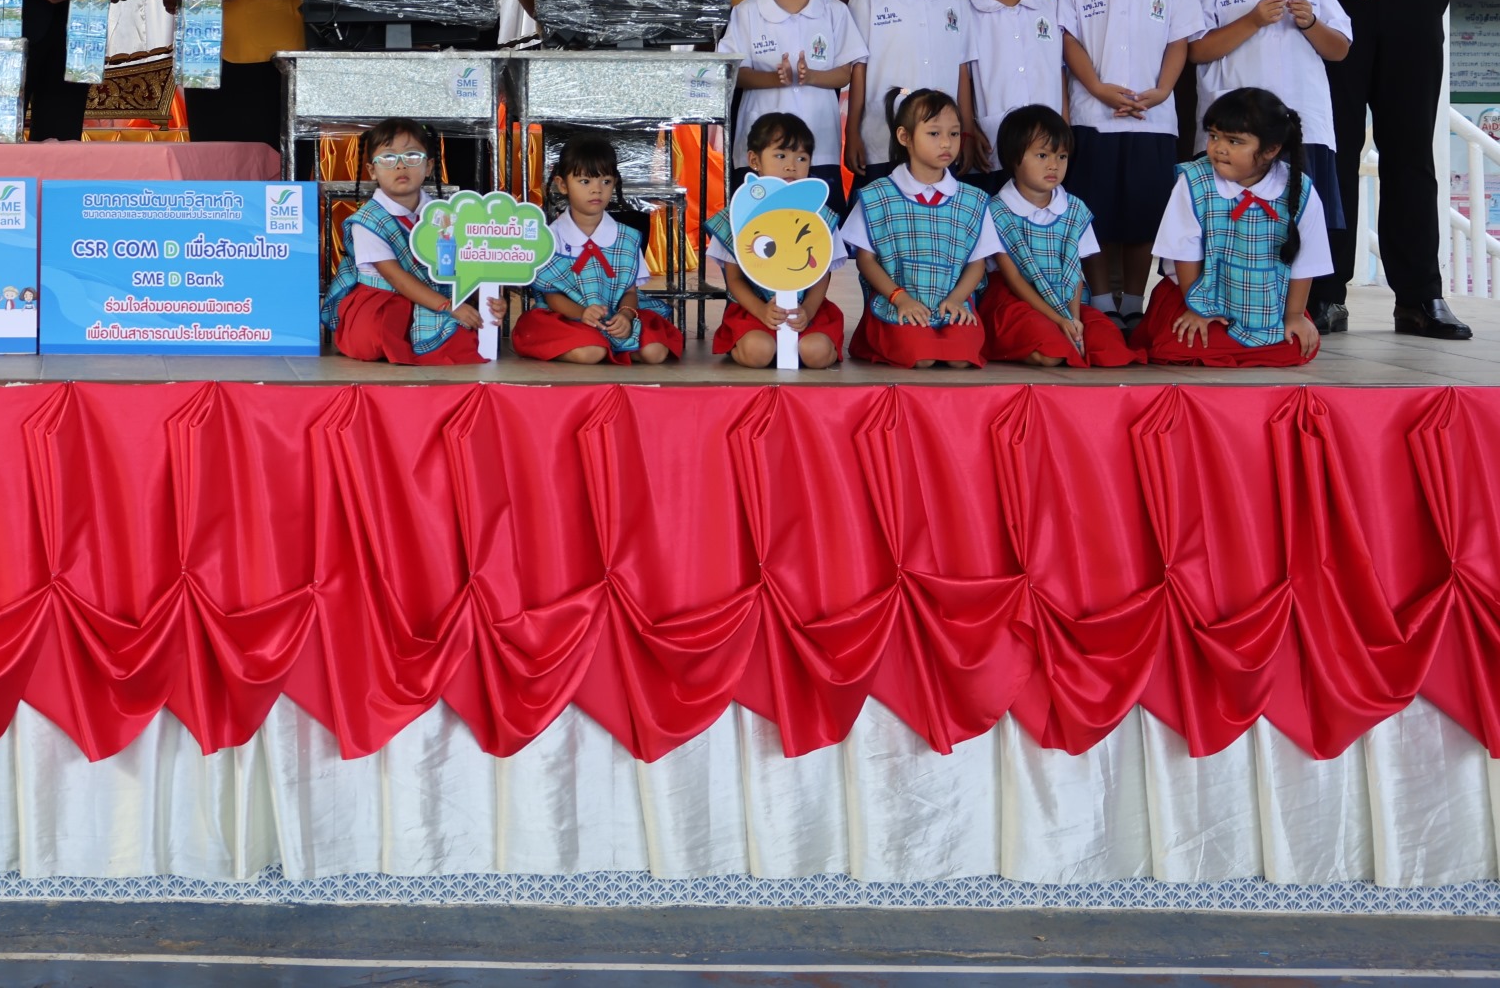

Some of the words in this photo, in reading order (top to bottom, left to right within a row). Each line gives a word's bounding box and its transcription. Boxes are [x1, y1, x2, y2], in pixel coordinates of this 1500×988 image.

[456, 79, 478, 87] SME
[82, 189, 244, 208] ธนาคารพัฒนาวิสาหกิจ
[270, 205, 299, 217] SME
[270, 220, 299, 230] Bank
[466, 217, 522, 237] แยกก่อนทิ้ง
[72, 240, 109, 259] CSR
[112, 240, 160, 259] COM
[164, 240, 180, 259] D
[185, 233, 290, 259] เพื่อสังคมไทย
[459, 240, 535, 262] เพื่อสิ่งแวดล้อม
[132, 271, 164, 287] SME
[168, 272, 181, 287] D
[185, 271, 224, 287] Bank
[104, 296, 252, 314] ร่วมใจส่งมอบคอมพิวเตอร์
[86, 321, 272, 341] เพื่อเป็นสาธารณประโยชน์ต่อสังคม
